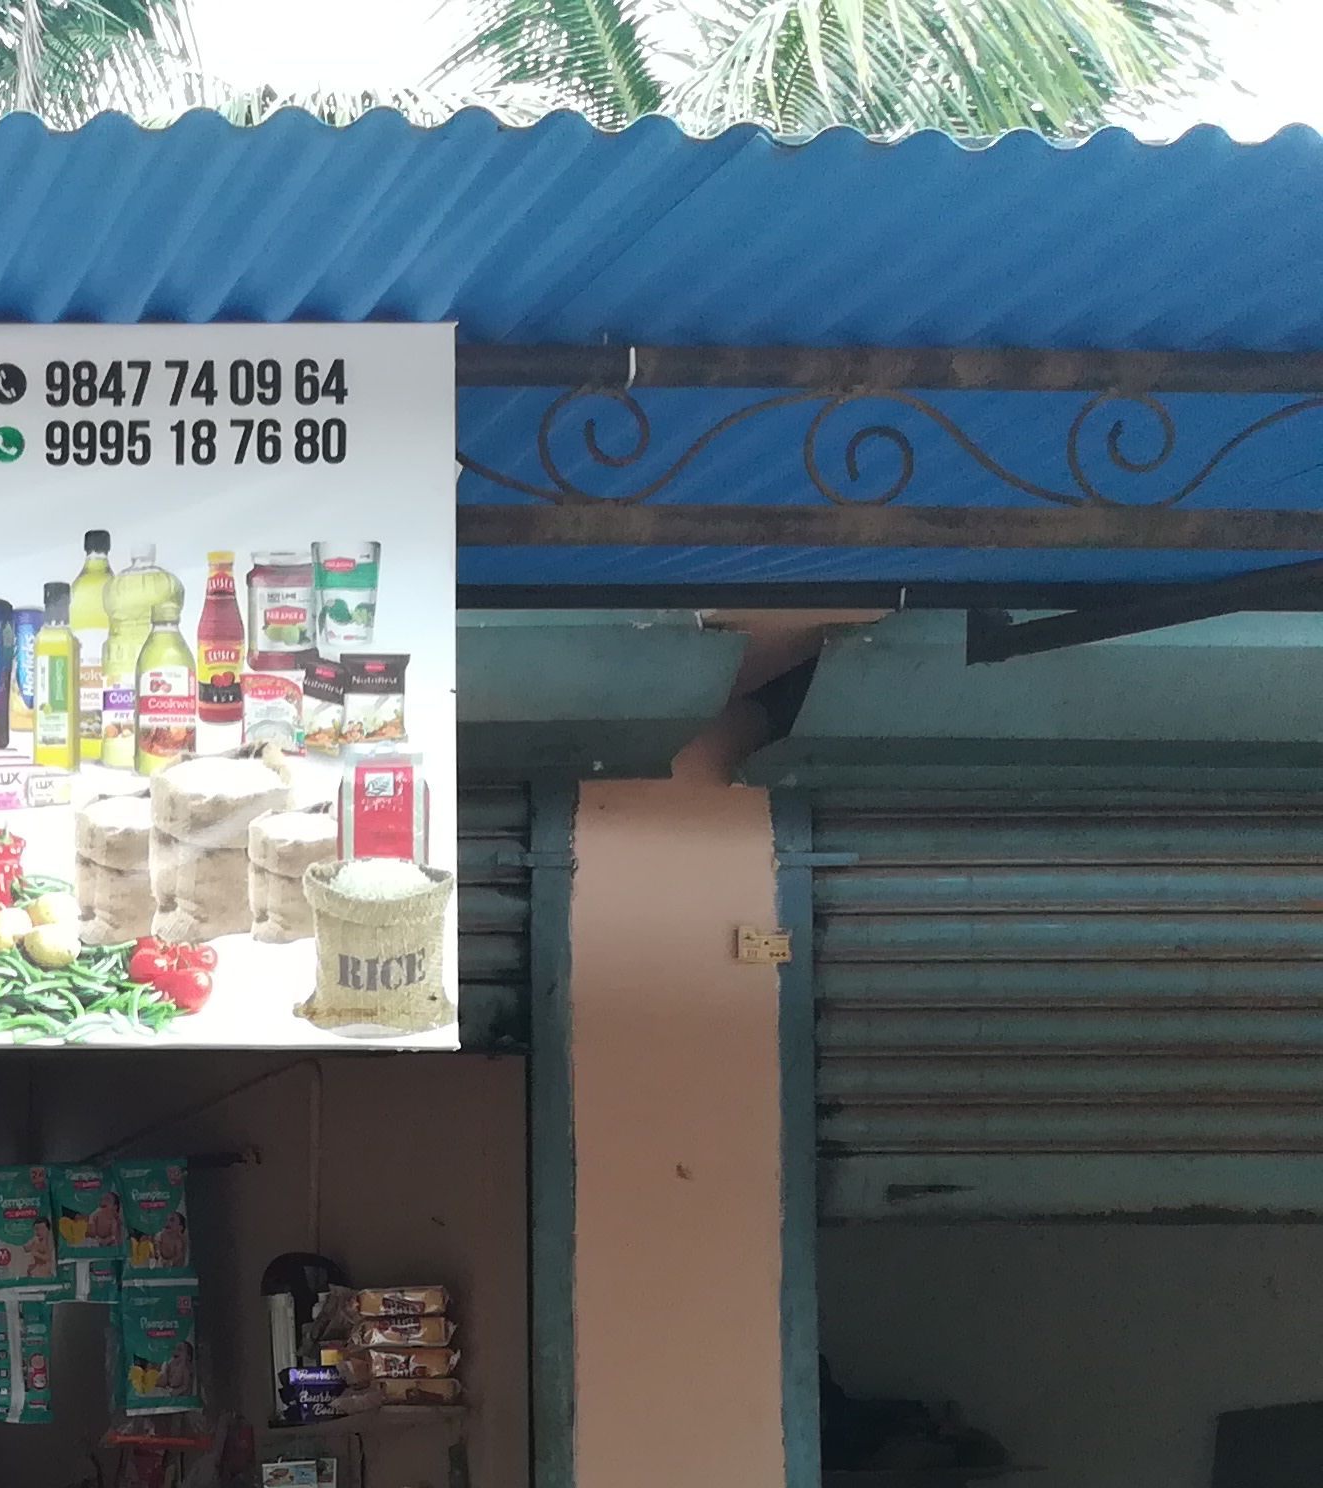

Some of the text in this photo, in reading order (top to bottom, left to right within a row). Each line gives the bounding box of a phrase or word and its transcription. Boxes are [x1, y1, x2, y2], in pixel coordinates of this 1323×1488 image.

[44, 358, 349, 407] 9847 74 09 64
[44, 418, 349, 467] 9995 18 76 80
[337, 947, 427, 992] RICE
